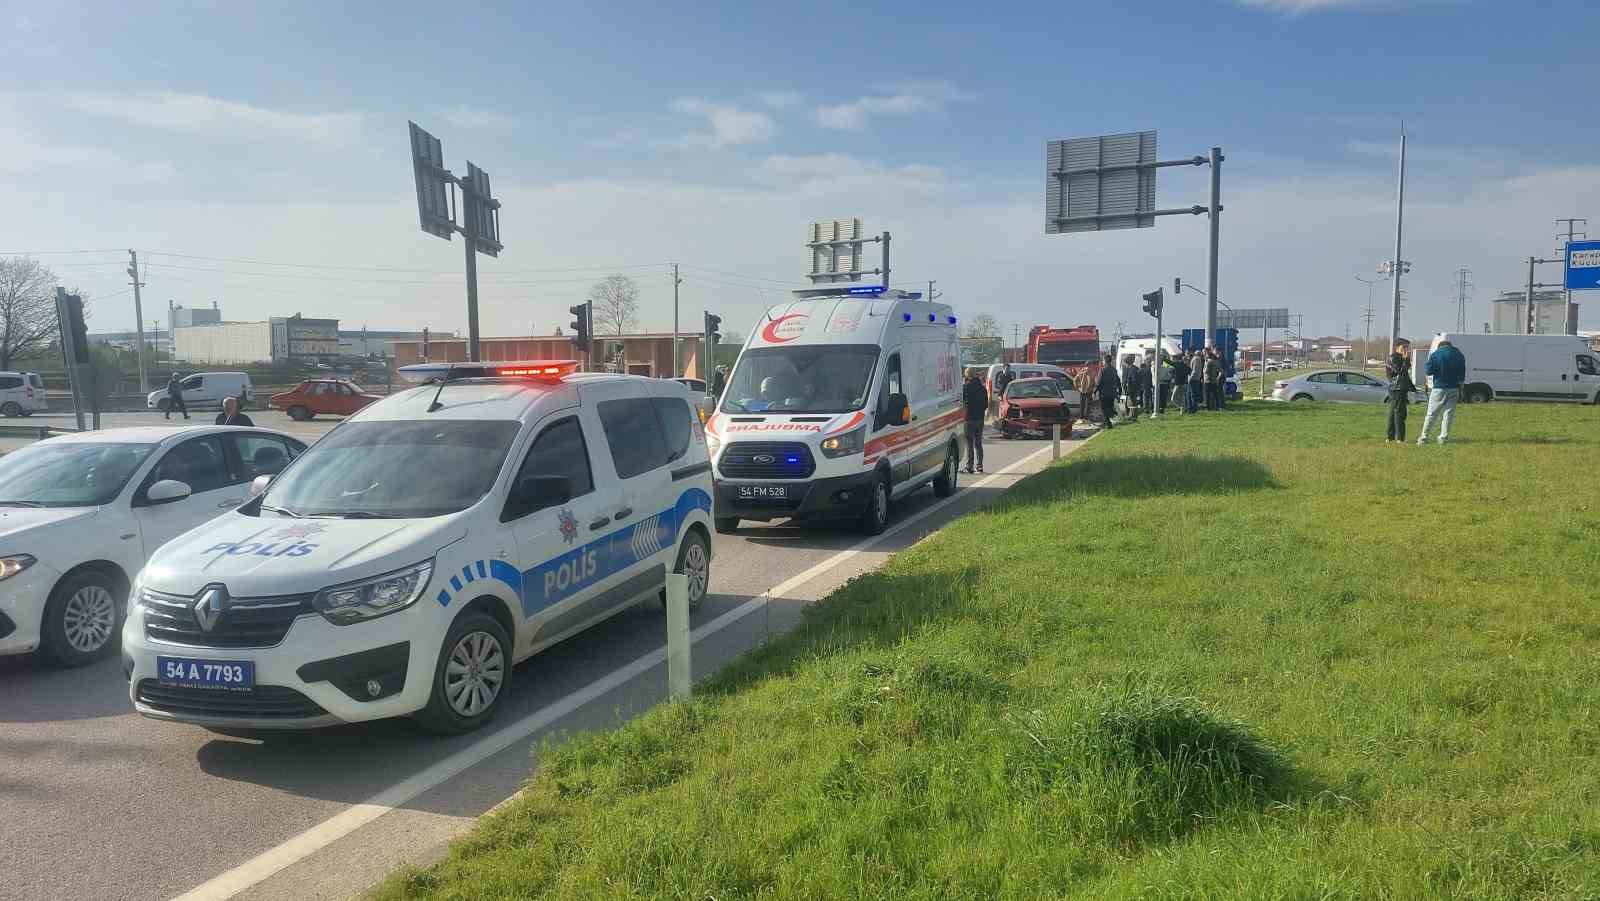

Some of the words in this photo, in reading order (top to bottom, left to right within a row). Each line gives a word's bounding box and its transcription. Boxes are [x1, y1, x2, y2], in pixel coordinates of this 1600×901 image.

[741, 487, 751, 496] 54
[753, 486, 767, 496] FM
[768, 487, 785, 496] 528
[544, 545, 597, 598] POLİS
[167, 661, 184, 679] 54
[189, 663, 200, 680] A
[203, 664, 243, 682] 7793
